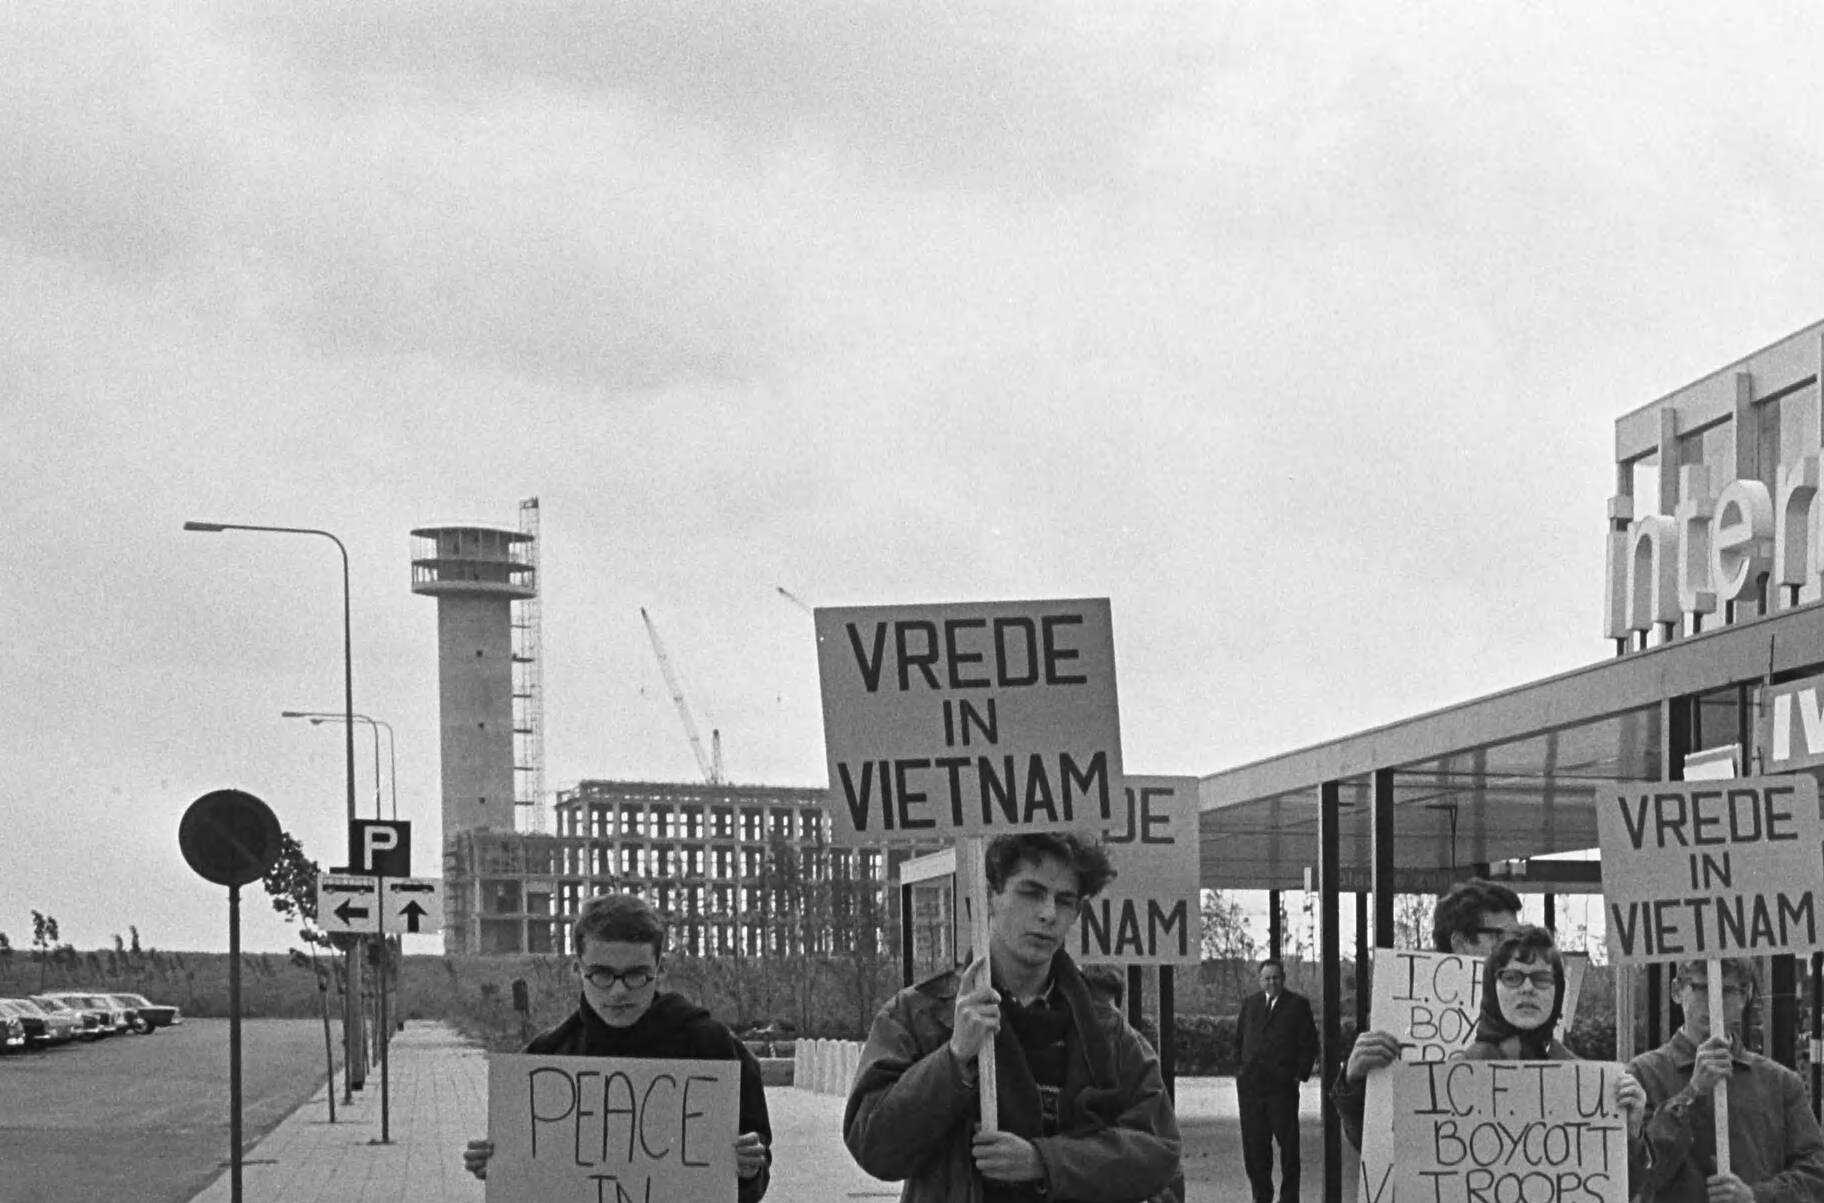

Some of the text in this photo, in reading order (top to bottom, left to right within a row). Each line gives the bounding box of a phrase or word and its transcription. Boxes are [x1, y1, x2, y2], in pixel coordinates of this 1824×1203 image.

[846, 613, 1087, 693] VREDE
[943, 698, 998, 746] IN
[837, 751, 1112, 832] VIETNAM
[1618, 786, 1799, 850] VREDE
[363, 825, 398, 870] P
[1690, 852, 1732, 890] IN
[1611, 891, 1817, 956] VIETNAM
[529, 1066, 718, 1168] PEACE
[1434, 1121, 1624, 1172] BOYCOTT
